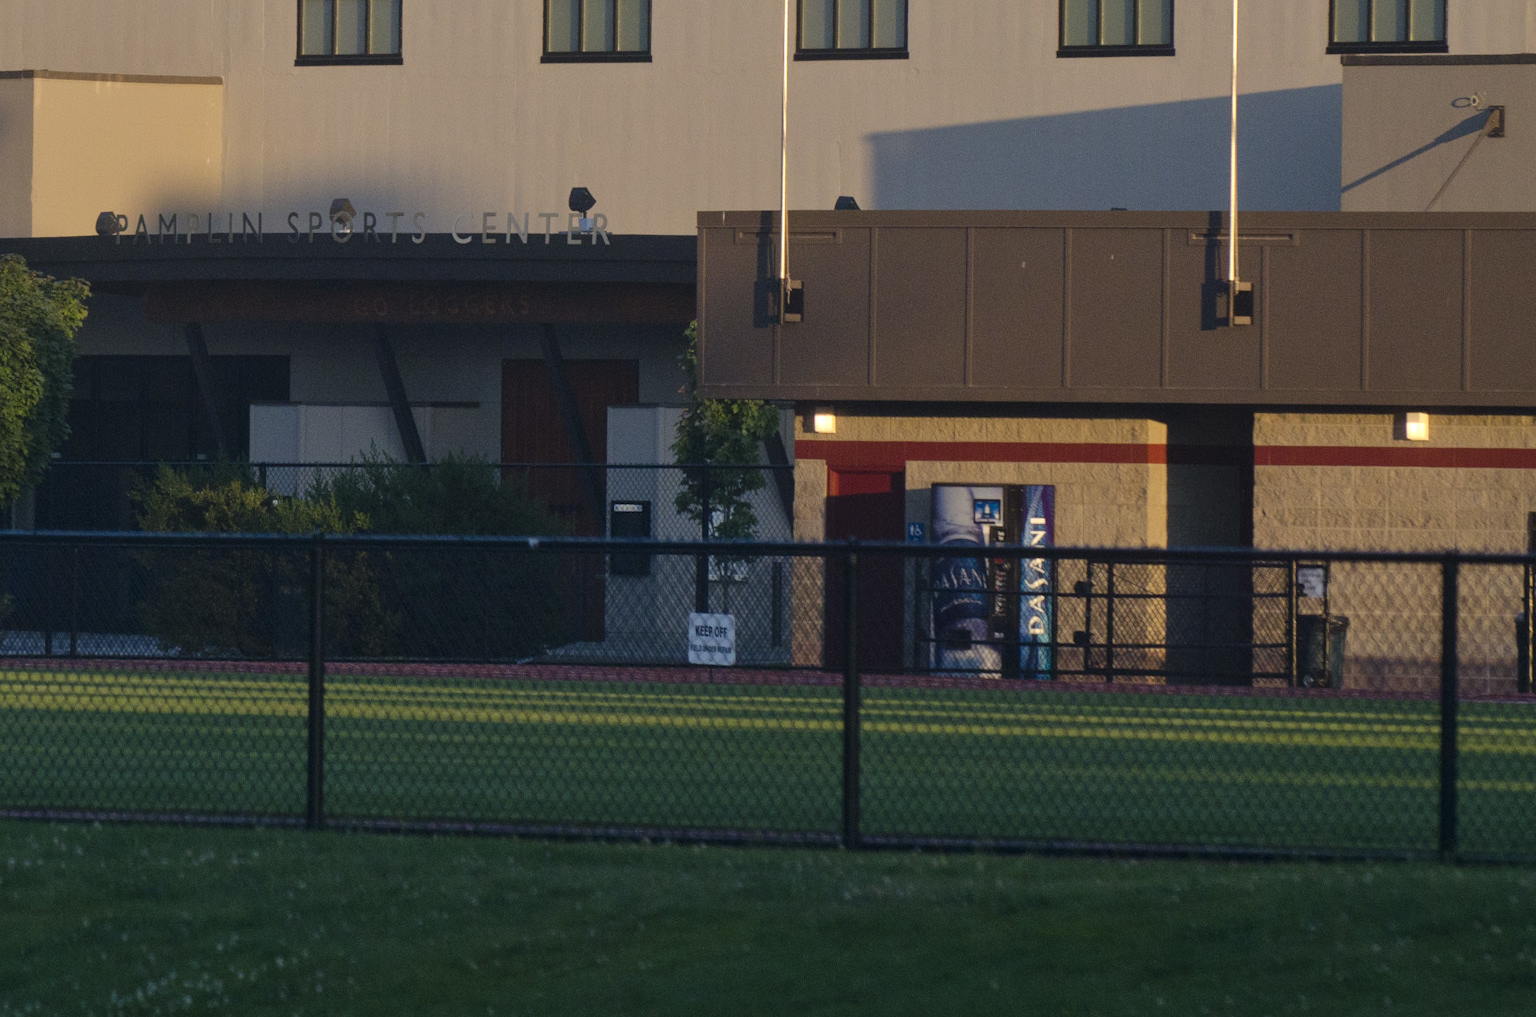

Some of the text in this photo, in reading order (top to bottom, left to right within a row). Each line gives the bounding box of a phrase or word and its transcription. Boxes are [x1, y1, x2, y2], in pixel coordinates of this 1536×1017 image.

[115, 211, 611, 245] PAMPLIN SPORTS CENTER
[409, 295, 530, 317] LOGGERS
[1025, 517, 1048, 635] DASANI
[695, 625, 727, 637] KEEP OFF
